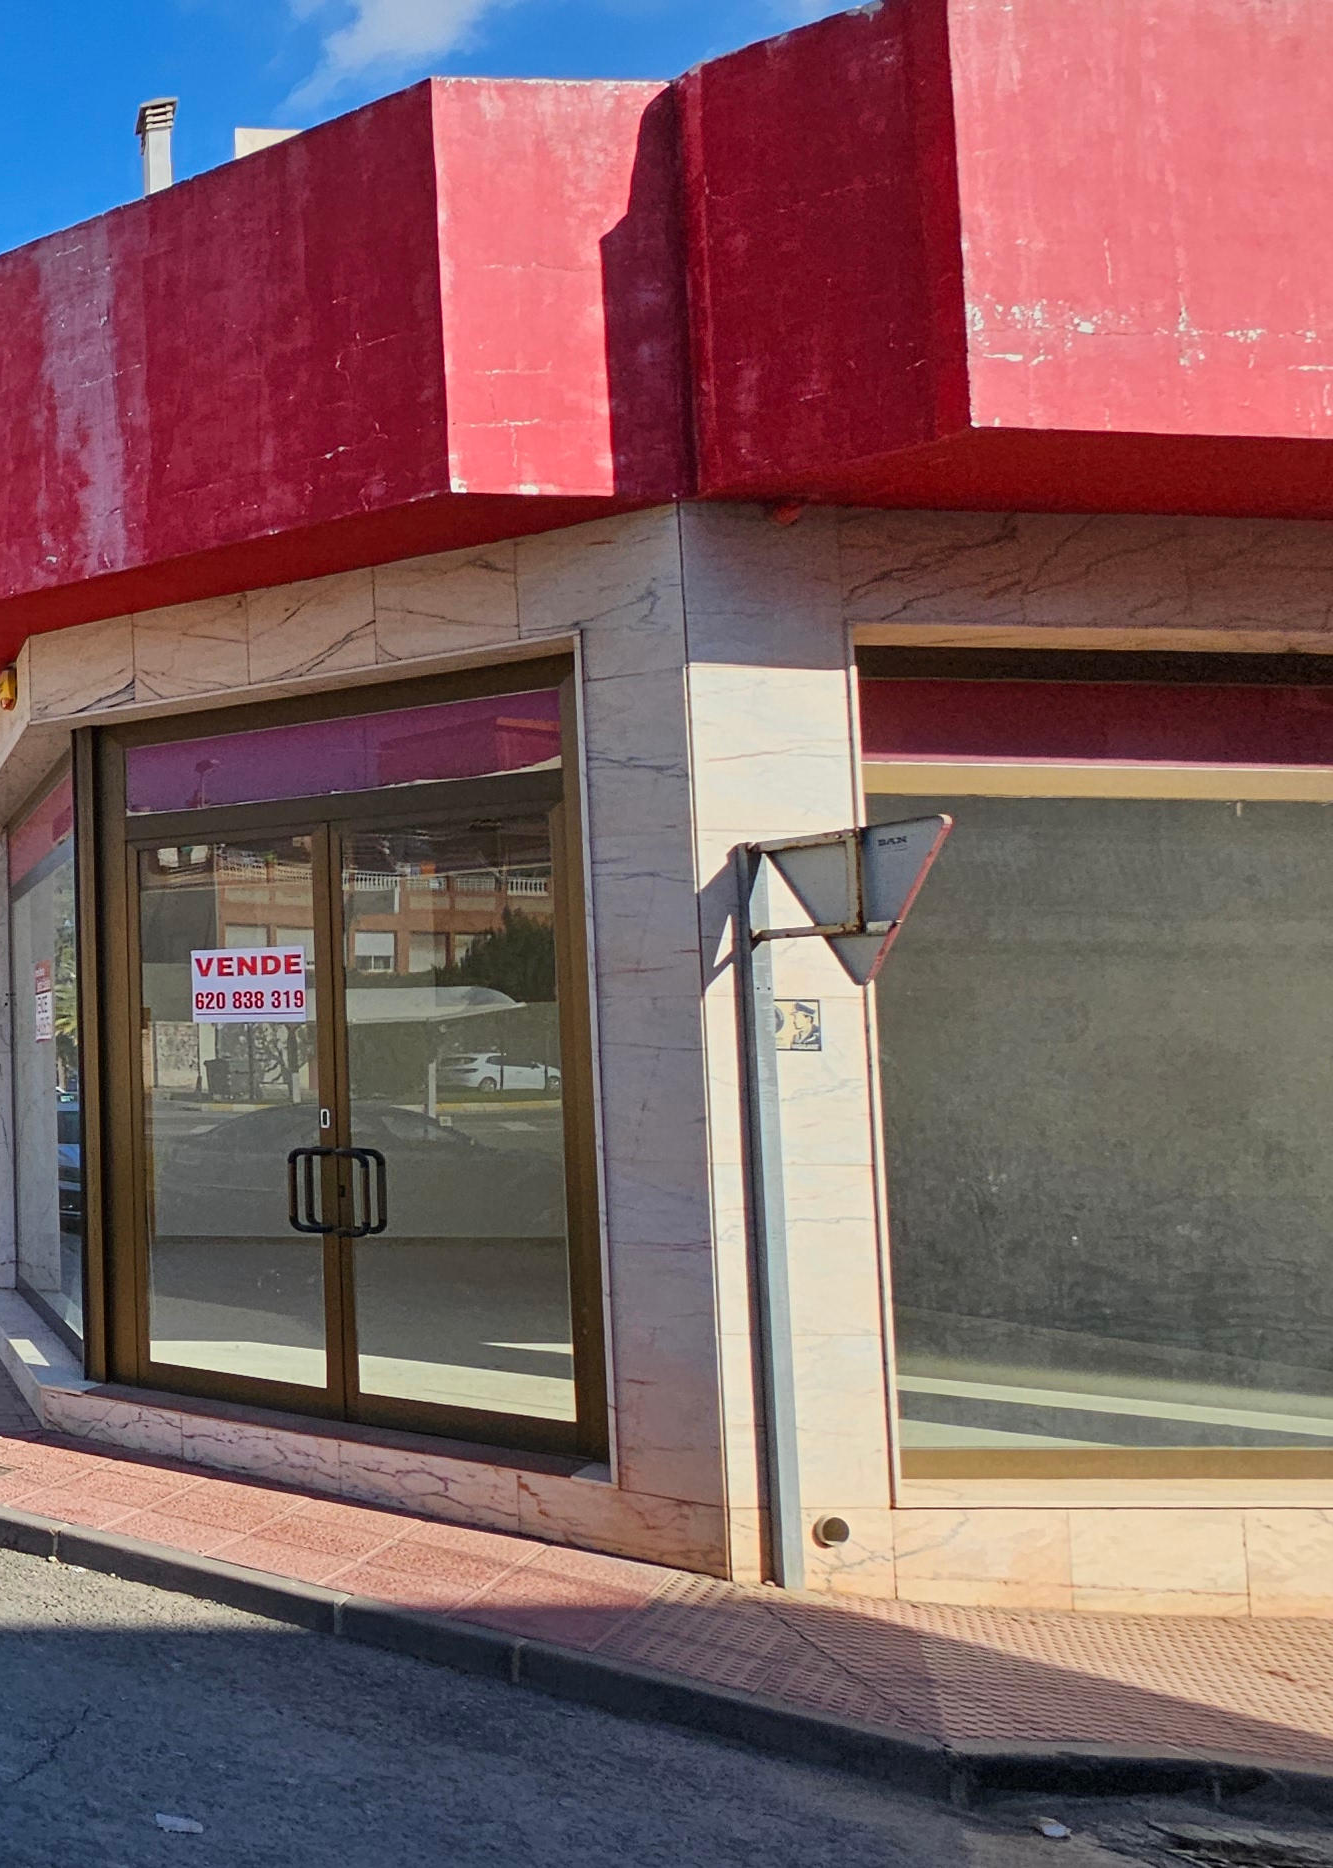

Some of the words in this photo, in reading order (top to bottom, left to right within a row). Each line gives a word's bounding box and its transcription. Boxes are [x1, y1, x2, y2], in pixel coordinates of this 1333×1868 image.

[194, 954, 302, 977] VENDE
[195, 992, 225, 1010] 620
[233, 991, 264, 1009] 838
[271, 990, 304, 1008] 319
